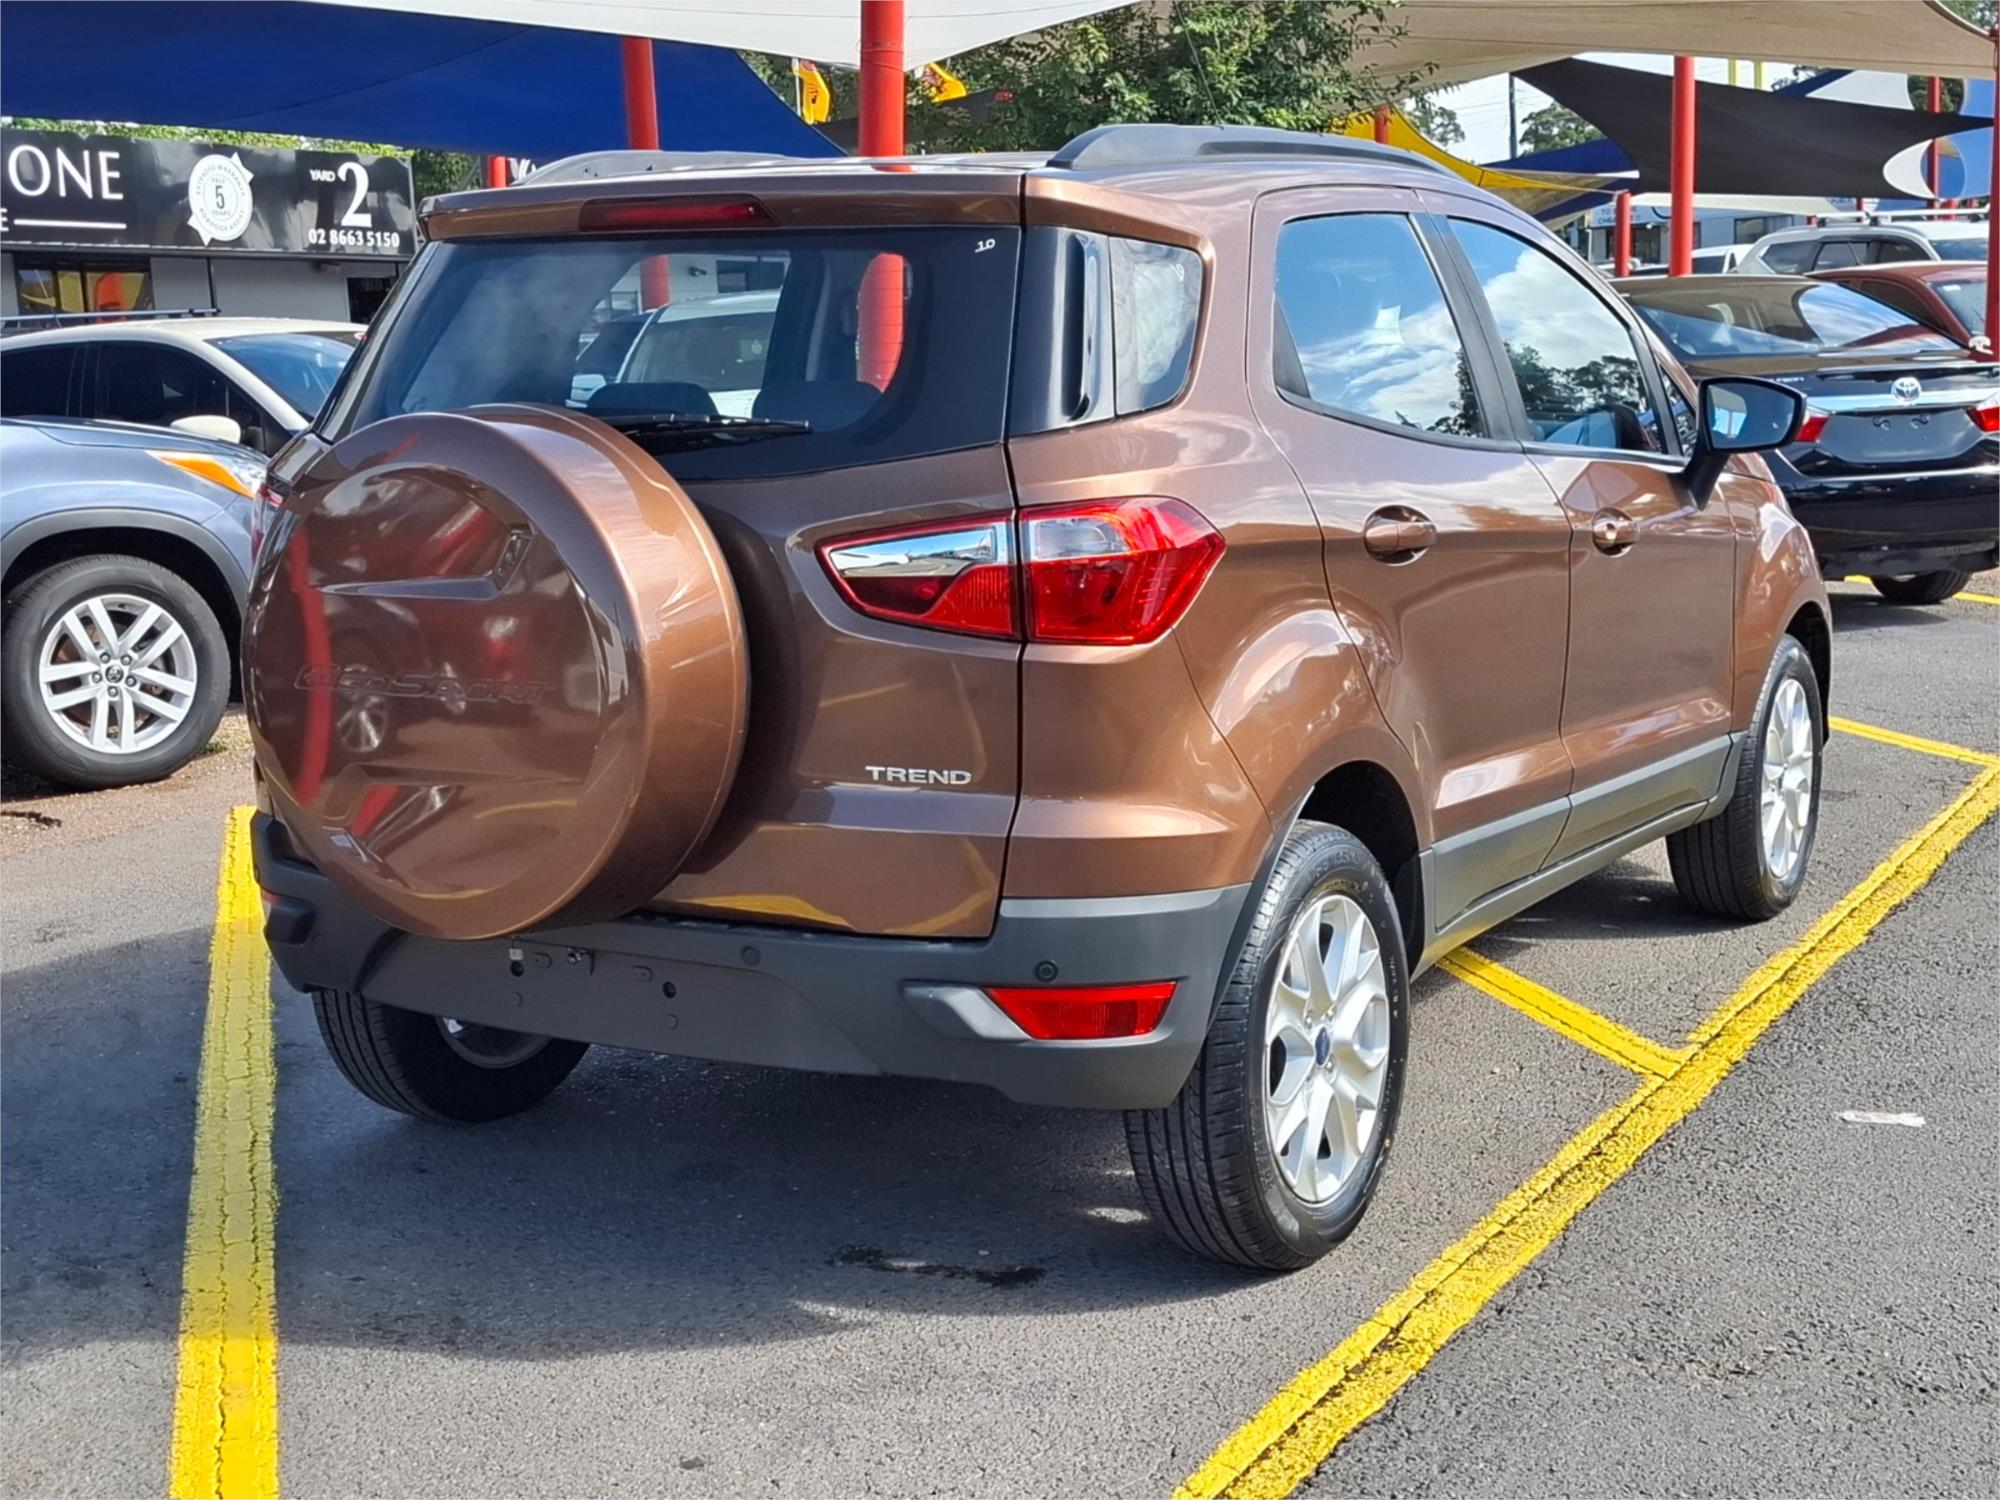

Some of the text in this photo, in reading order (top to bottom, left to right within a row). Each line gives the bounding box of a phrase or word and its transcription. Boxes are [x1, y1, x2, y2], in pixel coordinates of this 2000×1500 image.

[8, 144, 124, 200] ONE
[215, 184, 226, 210] 5
[309, 161, 373, 228] YARD 2
[308, 227, 400, 248] 02 8663 5150
[865, 765, 972, 785] TREND
